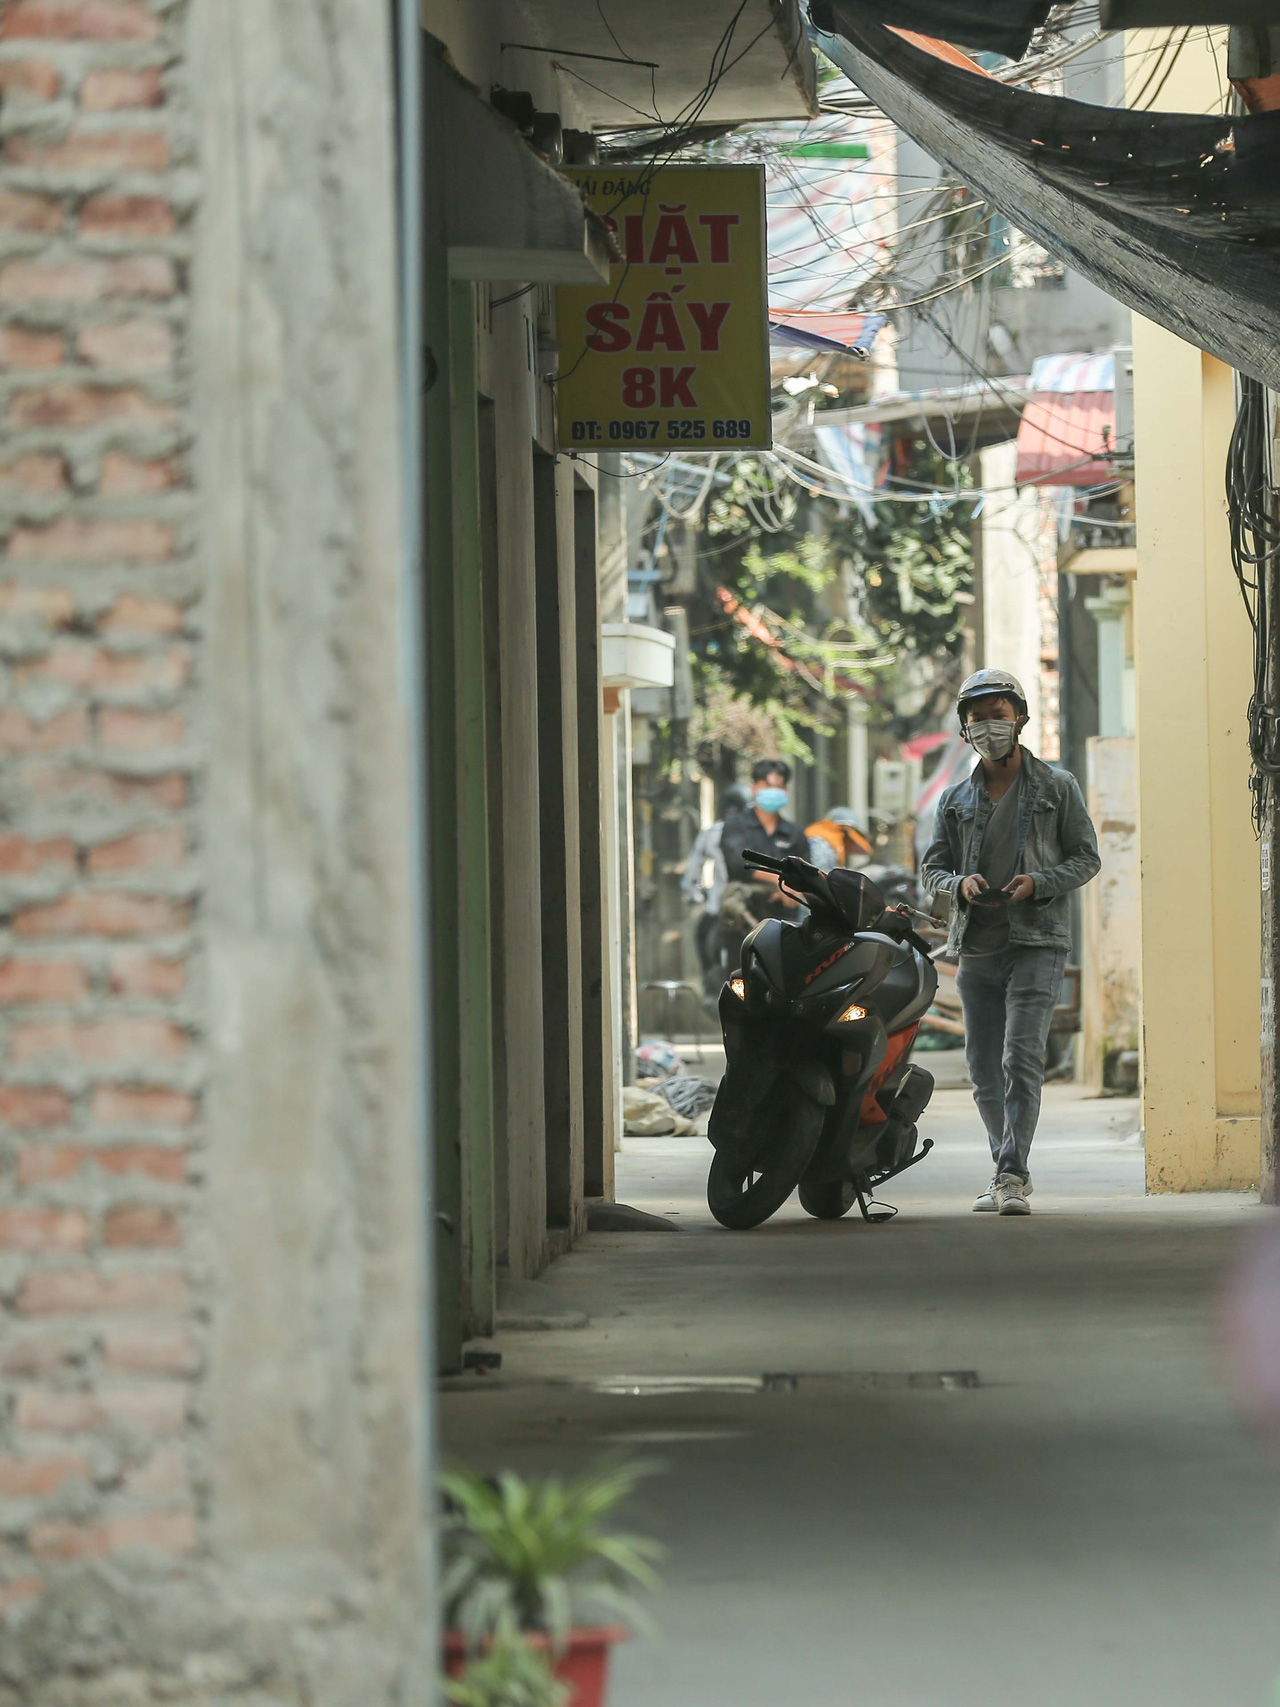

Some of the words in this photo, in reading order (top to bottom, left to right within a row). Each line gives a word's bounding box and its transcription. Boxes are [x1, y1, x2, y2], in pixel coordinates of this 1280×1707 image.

[601, 204, 739, 275] IẶT
[585, 285, 731, 351] SẤY
[622, 367, 698, 408] 8K
[572, 421, 602, 440] ĐT:
[609, 421, 660, 440] 0967
[667, 420, 705, 439] 525
[712, 420, 751, 439] 689
